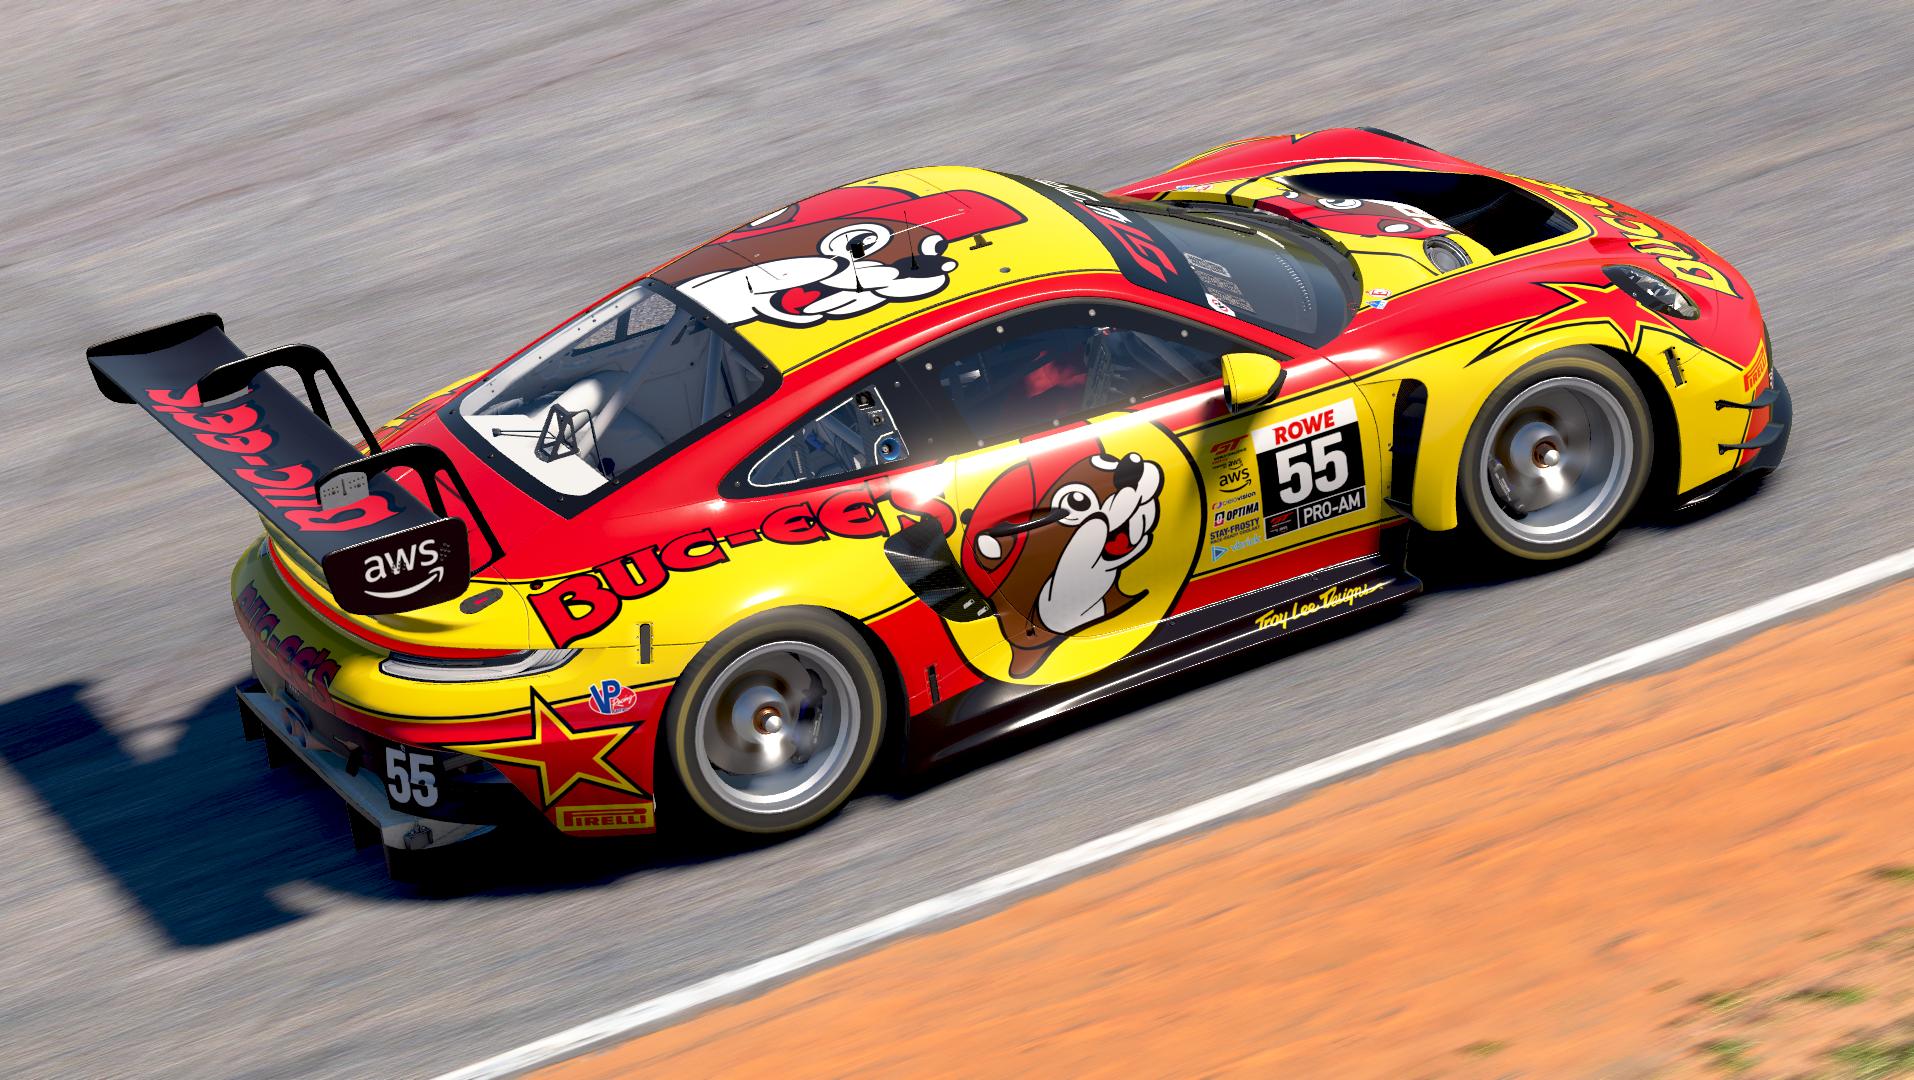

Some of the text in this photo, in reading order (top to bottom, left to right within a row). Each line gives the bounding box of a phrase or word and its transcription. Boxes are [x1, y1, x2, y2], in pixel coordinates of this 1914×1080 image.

[1744, 347, 1768, 392] PIRELLI
[1273, 409, 1335, 445] ROWE
[1219, 469, 1250, 486] aws
[1275, 432, 1348, 504] 55
[1226, 502, 1259, 521] OPTIMA
[1303, 492, 1361, 524] PRO-AM
[1210, 517, 1260, 539] STAY-FROSTY
[364, 538, 439, 583] aws
[1254, 583, 1384, 630] Troy Lee Designs
[589, 679, 621, 714] VP
[385, 746, 439, 808] 55
[563, 807, 646, 825] PIRELLI
